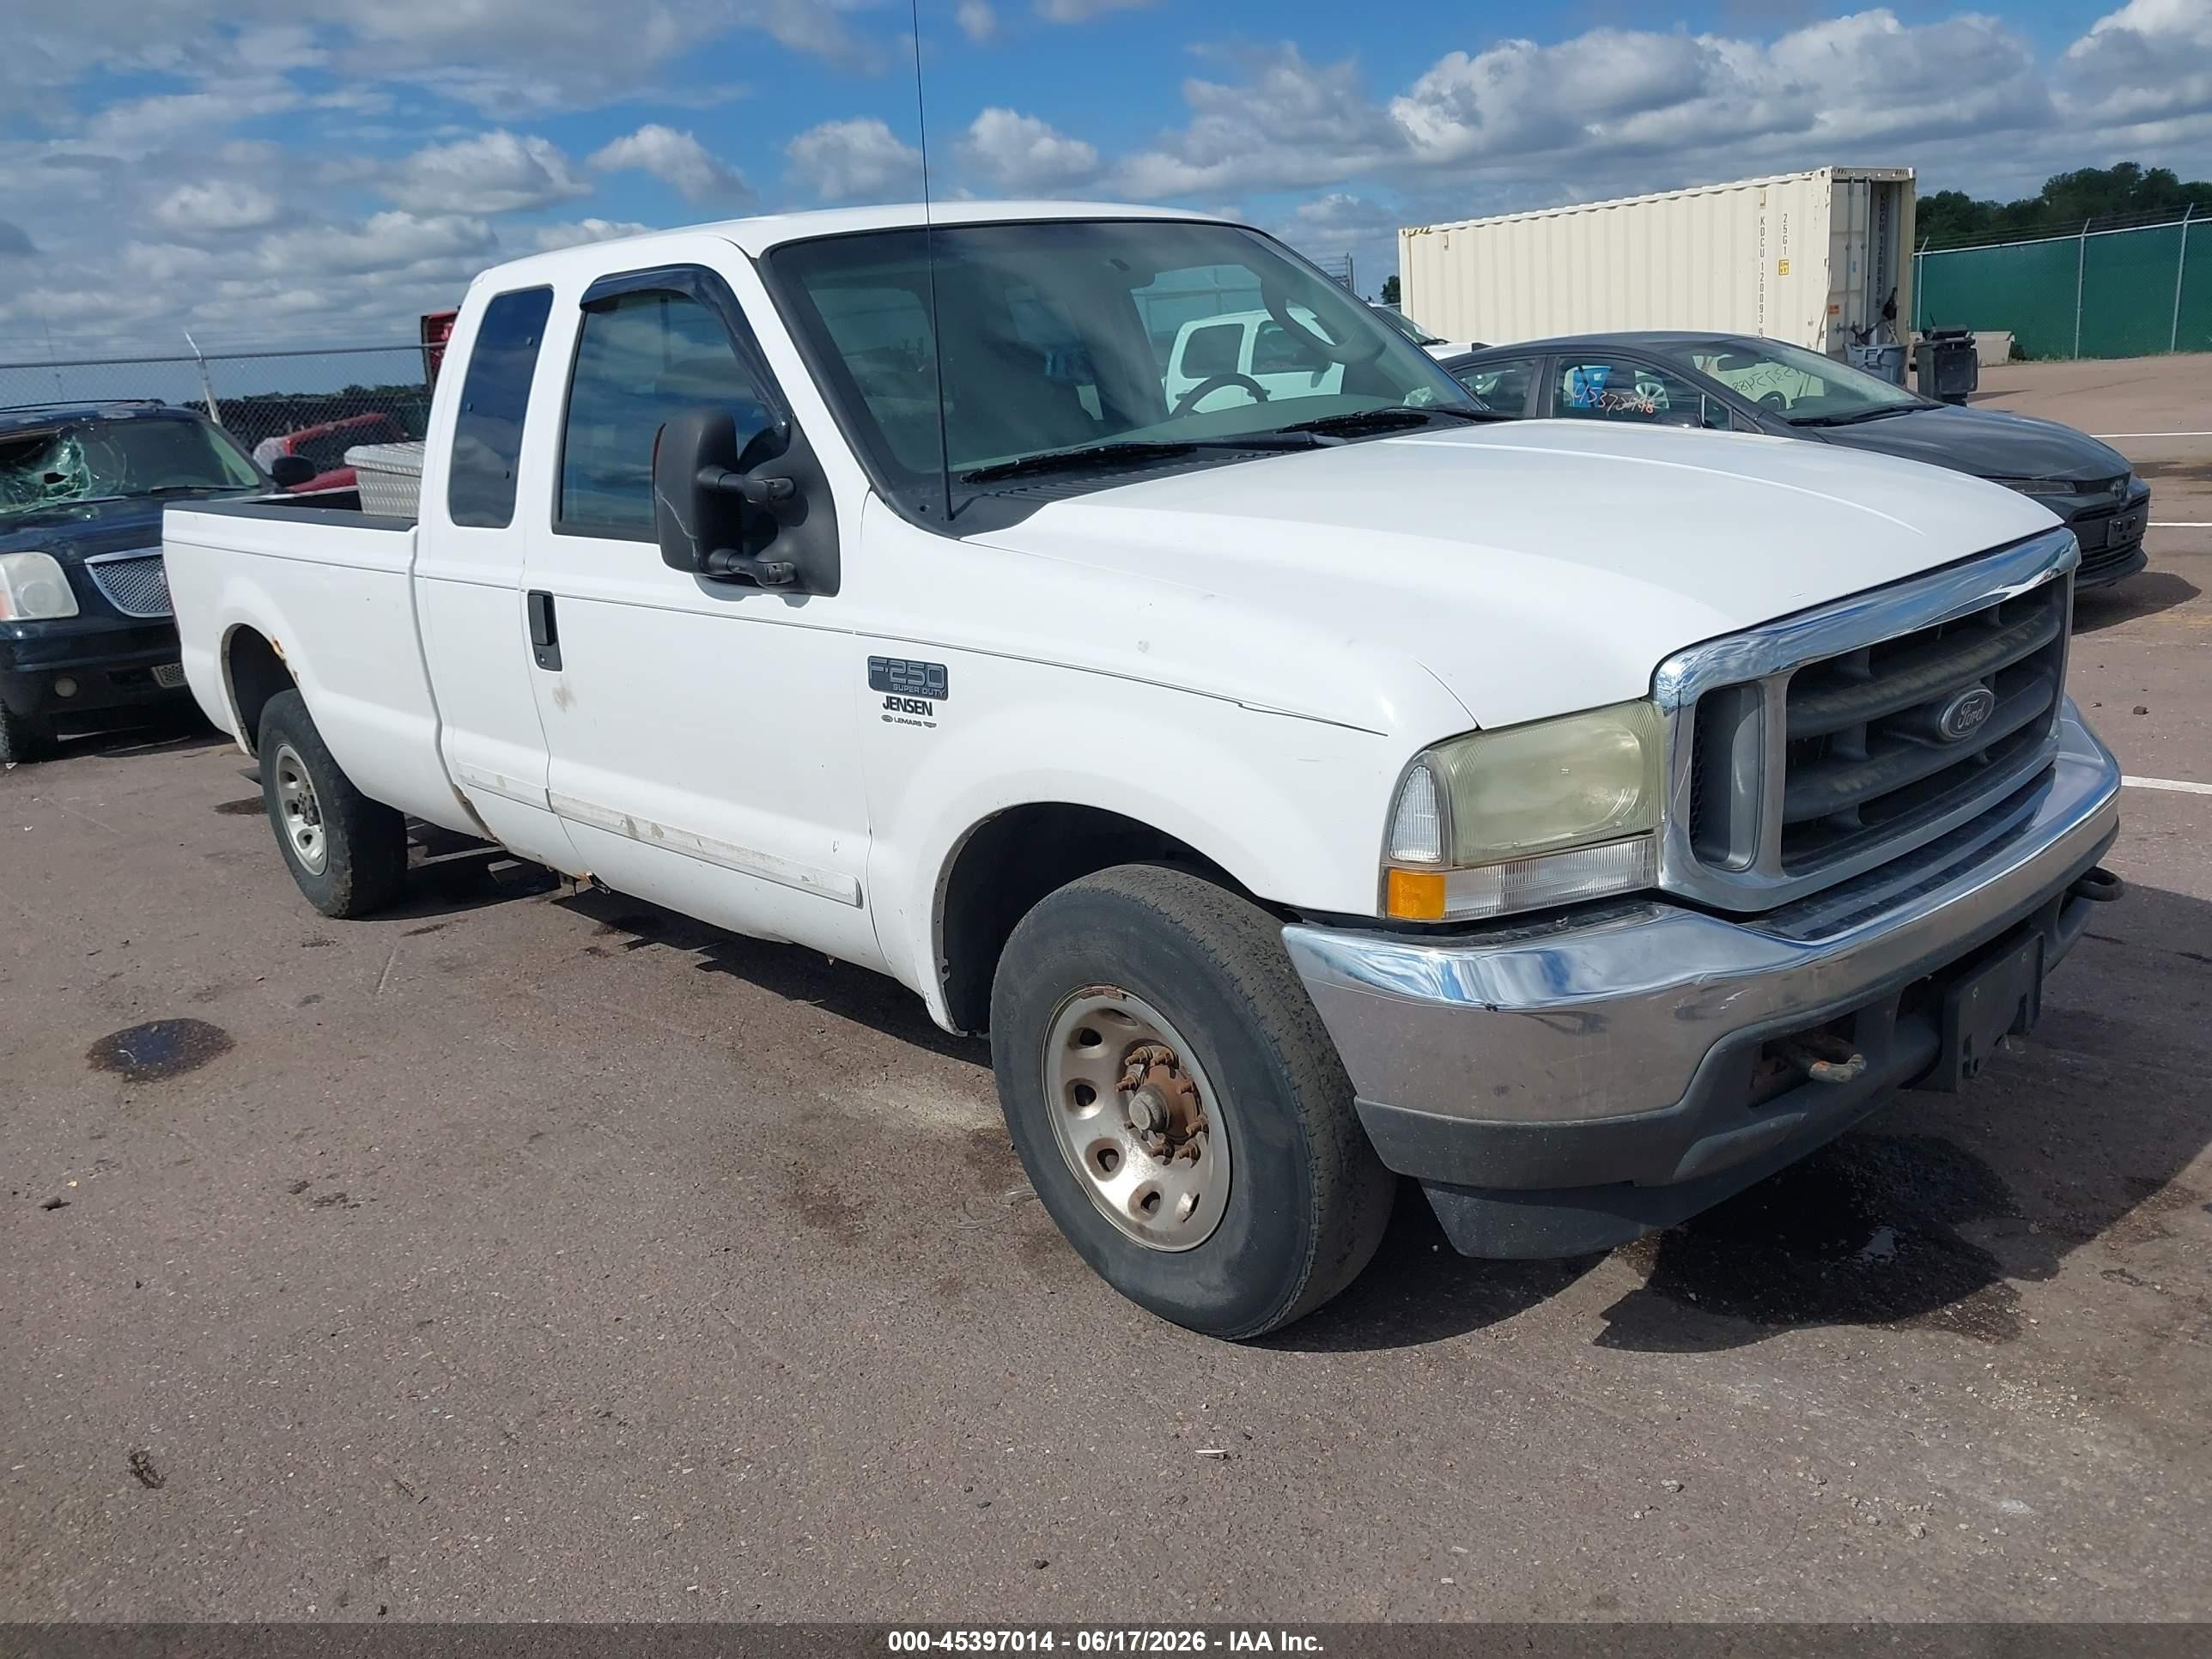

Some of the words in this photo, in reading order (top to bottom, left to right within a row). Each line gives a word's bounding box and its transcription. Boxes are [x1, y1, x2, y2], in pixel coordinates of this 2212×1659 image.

[892, 684, 920, 695] SUPER
[922, 688, 945, 697] DUTY
[882, 695, 933, 717] JENSEN
[1958, 698, 1985, 730] Ford
